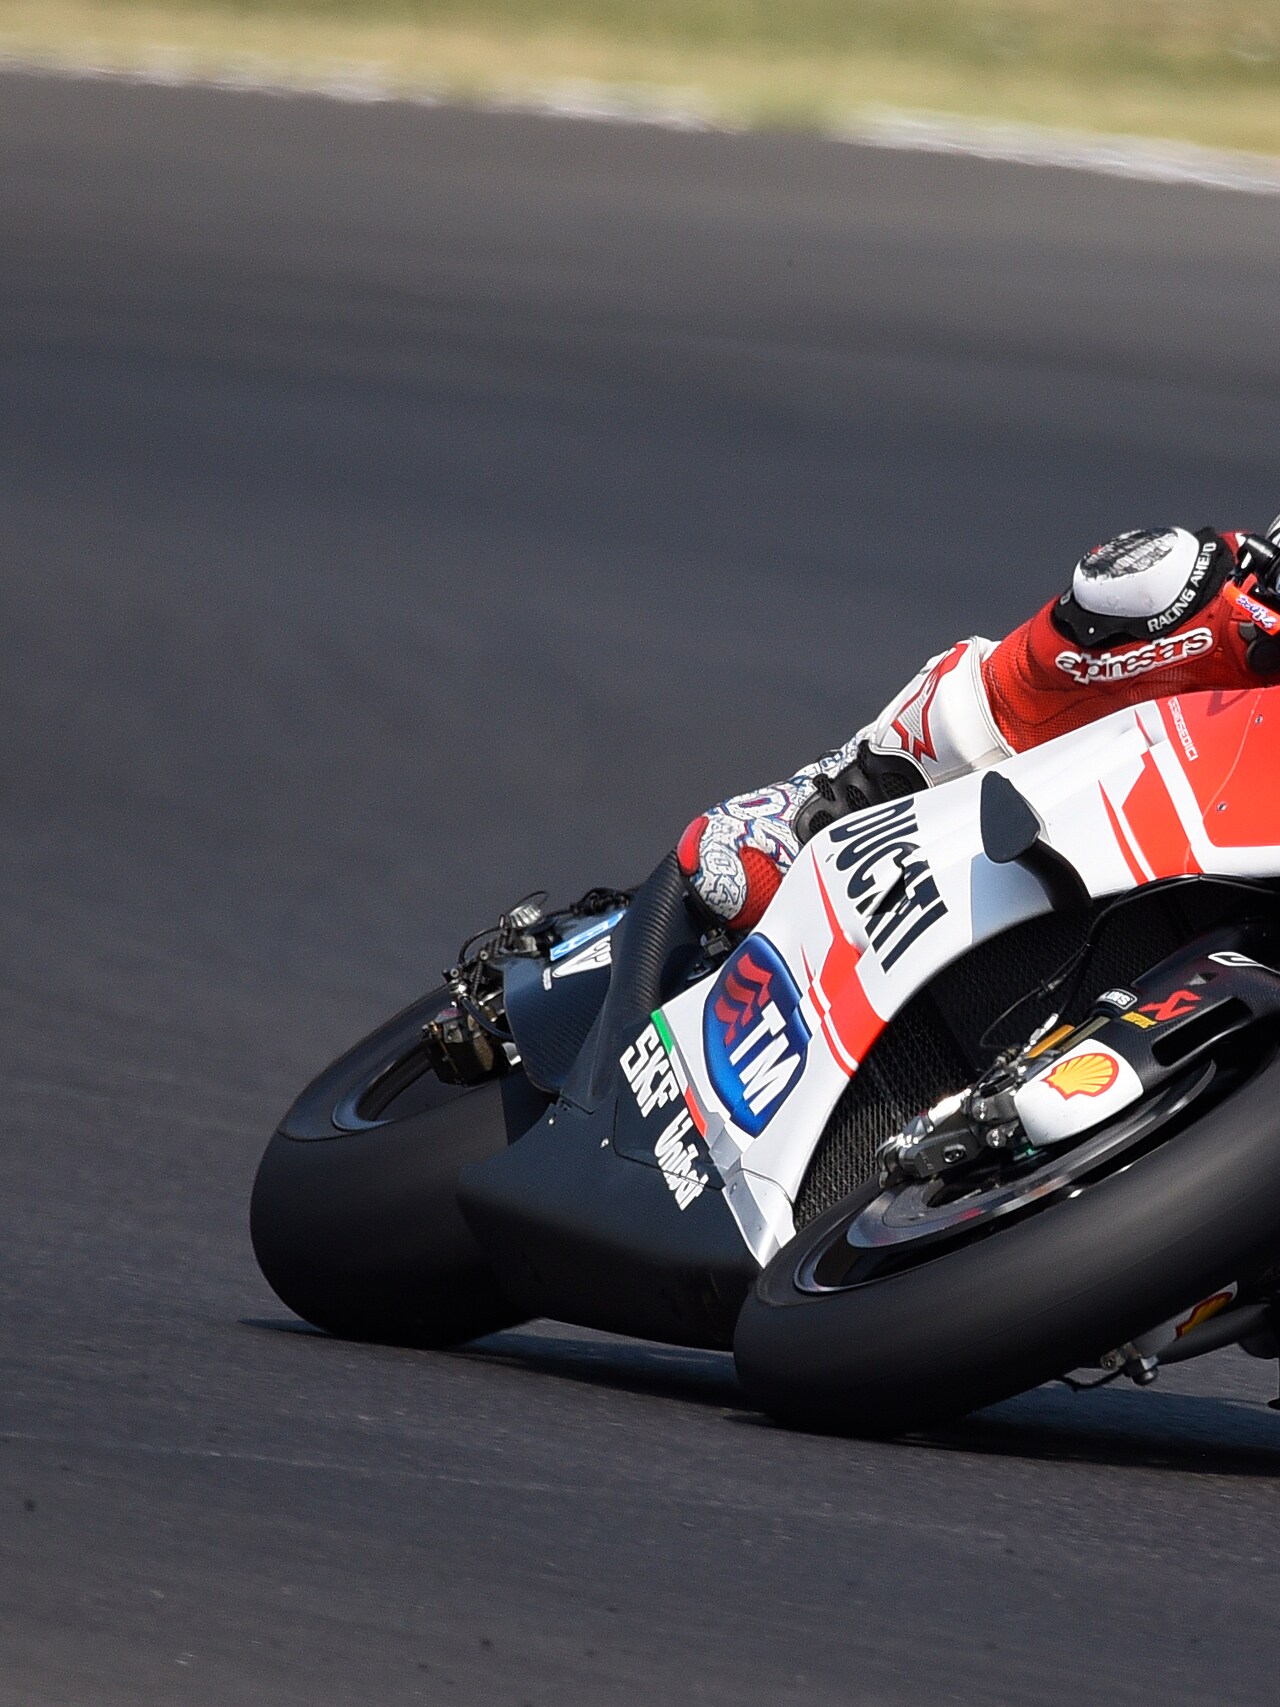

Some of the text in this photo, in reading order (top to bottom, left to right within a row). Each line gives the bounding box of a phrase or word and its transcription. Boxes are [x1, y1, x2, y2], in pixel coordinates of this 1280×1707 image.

[1147, 541, 1218, 633] RACING AHED
[829, 796, 949, 975] DUCATI
[618, 1022, 681, 1119] SKF
